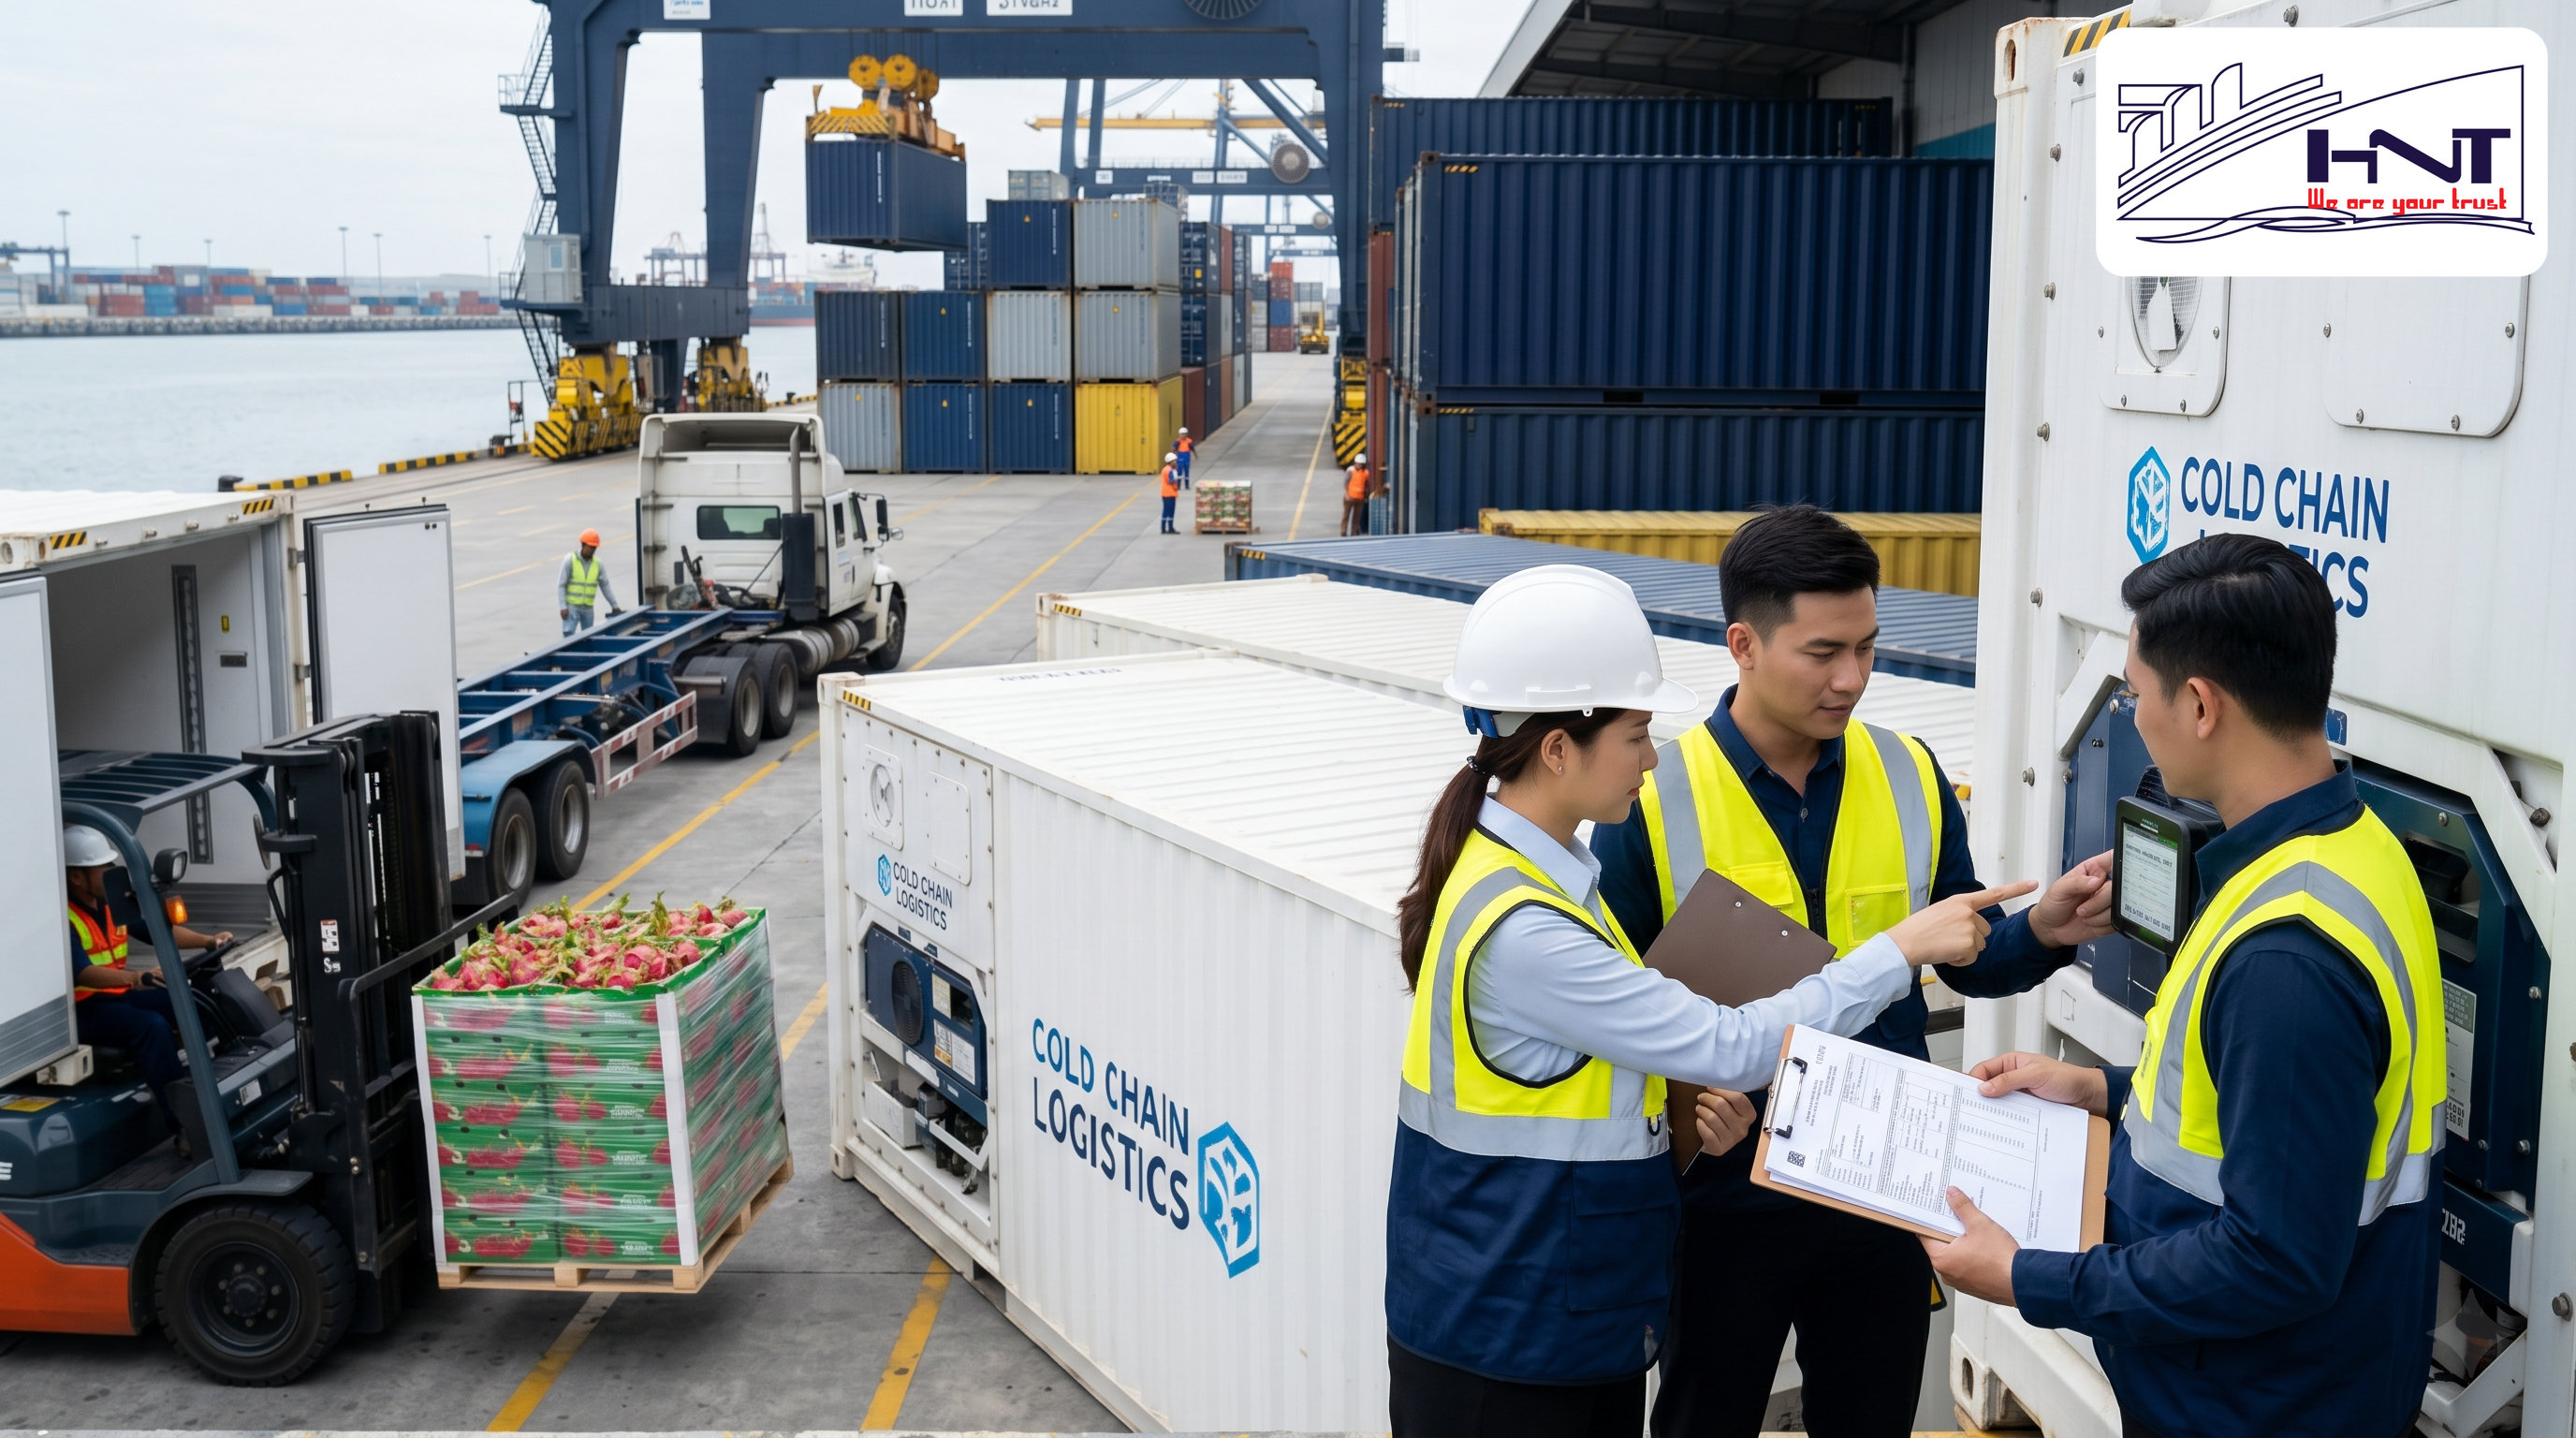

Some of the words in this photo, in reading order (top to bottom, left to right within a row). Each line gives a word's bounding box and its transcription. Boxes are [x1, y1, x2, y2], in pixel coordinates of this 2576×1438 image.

[2181, 456, 2265, 522] COLD
[2275, 466, 2390, 544] CHAIN
[893, 861, 919, 890] COLD
[920, 876, 953, 909] CHAIN
[896, 887, 947, 931] LOGISTICS
[1032, 1018, 1095, 1093] COLD
[1105, 1061, 1189, 1156] CHAIN
[1033, 1077, 1190, 1231] LOGISTICS
